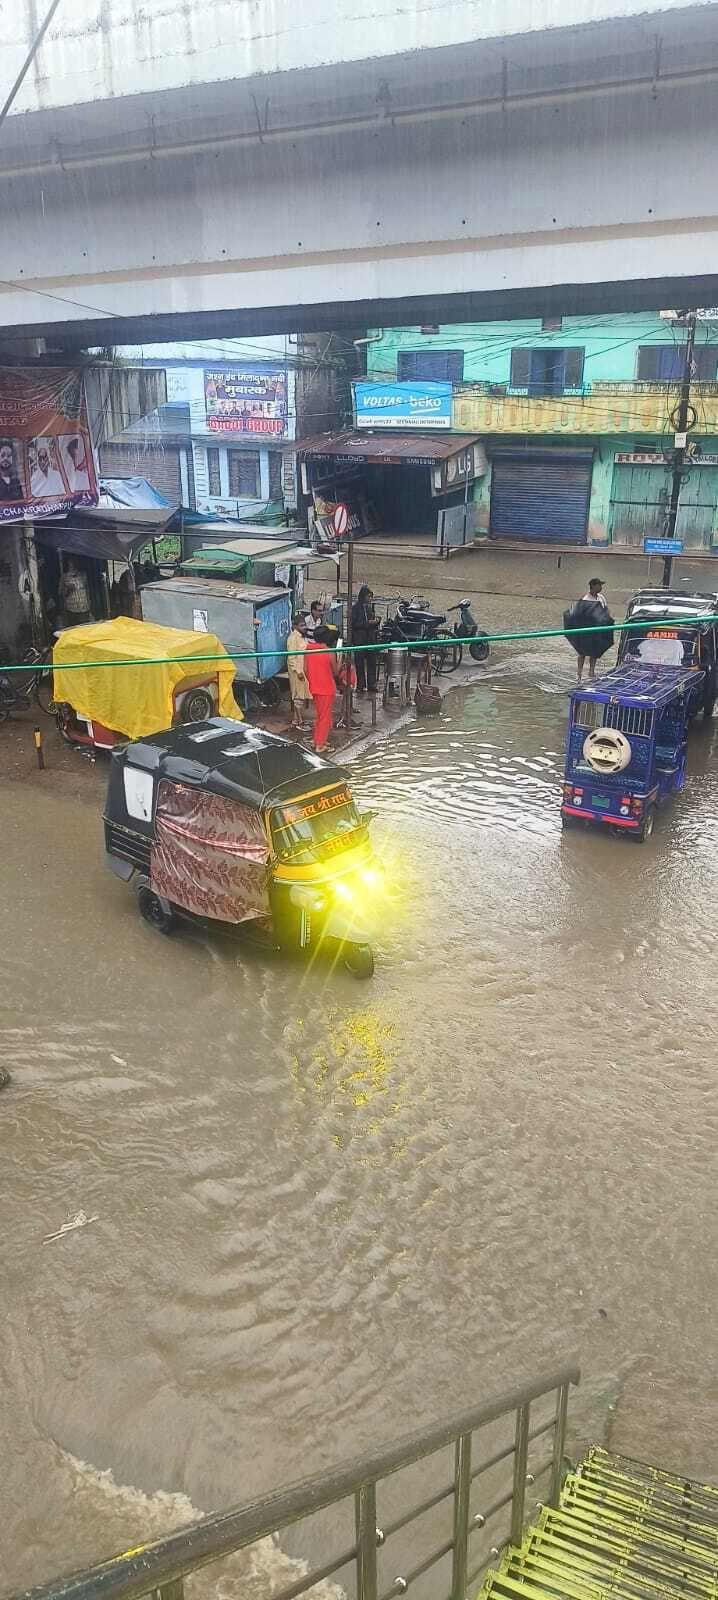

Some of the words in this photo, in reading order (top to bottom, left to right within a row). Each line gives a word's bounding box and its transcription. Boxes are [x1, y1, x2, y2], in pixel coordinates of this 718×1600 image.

[224, 386, 266, 397] मुबारक
[363, 396, 402, 408] VOLTAS
[409, 395, 442, 407] beko
[248, 418, 283, 433] GROUP
[457, 454, 472, 474] LG
